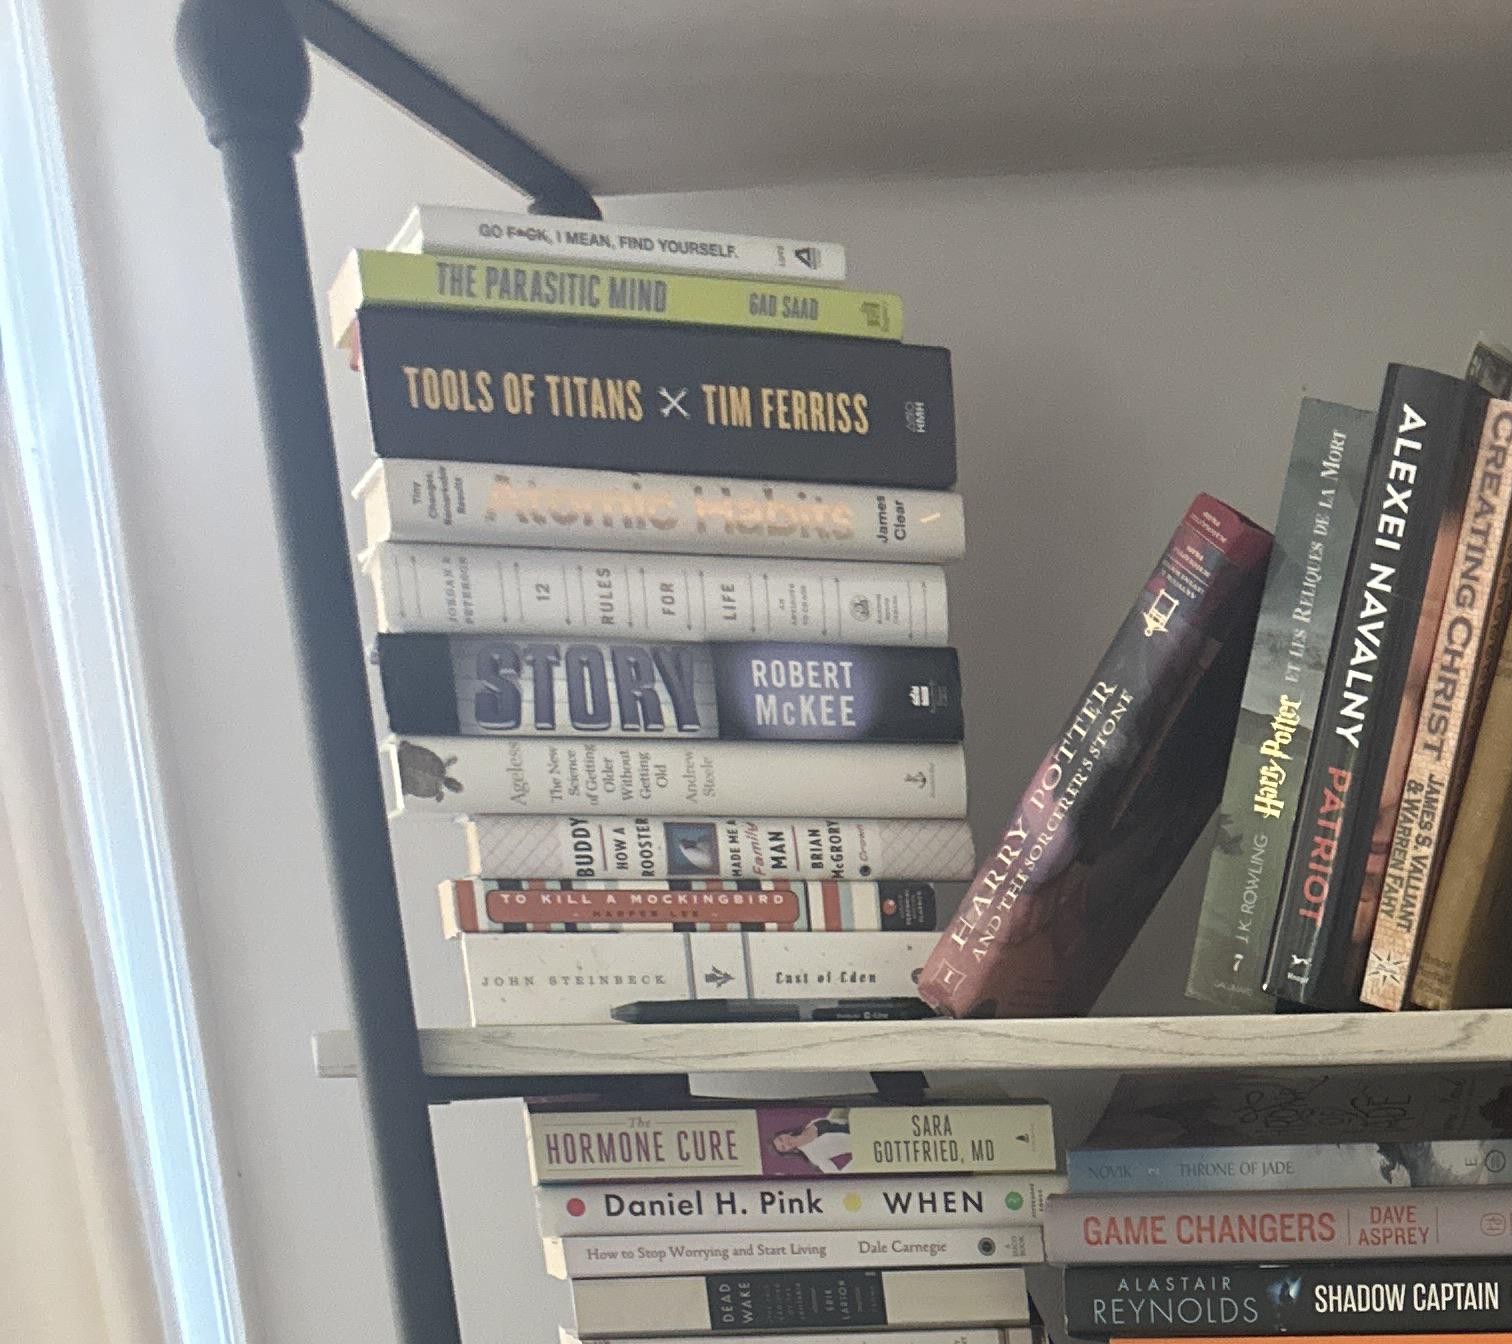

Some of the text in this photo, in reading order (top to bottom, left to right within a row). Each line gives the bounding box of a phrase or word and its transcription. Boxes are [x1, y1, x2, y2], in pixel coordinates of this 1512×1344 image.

[436, 261, 668, 315] THE PARASITIC MIND
[749, 292, 819, 321] GAD SAAD
[403, 365, 644, 422] TOOLS OF TITANS
[701, 384, 869, 435] TIM FERRISS
[1335, 403, 1428, 748] ALEXEI NAVALNY
[473, 641, 702, 734] STORY
[751, 658, 853, 690] ROBERT
[1419, 613, 1474, 761] CHRIST
[755, 693, 857, 728] McKEE
[951, 679, 1119, 952] HARRY POTTER
[1298, 765, 1353, 927] PATRIOT
[500, 892, 785, 906] TO KILL A MOCKINGBIRD
[911, 1114, 952, 1138] SARA
[546, 1129, 739, 1165] HORMONE CURE
[873, 1137, 995, 1165] GOTTFRIED, MD
[605, 1190, 983, 1217] Daniel H. Pink WHEN
[858, 1240, 947, 1254] Dale Carnegie
[1118, 1276, 1231, 1292] ALASTAIR
[1314, 1282, 1499, 1313] SHADOW CAPTAIN
[1093, 1297, 1259, 1324] REYNOLDS
